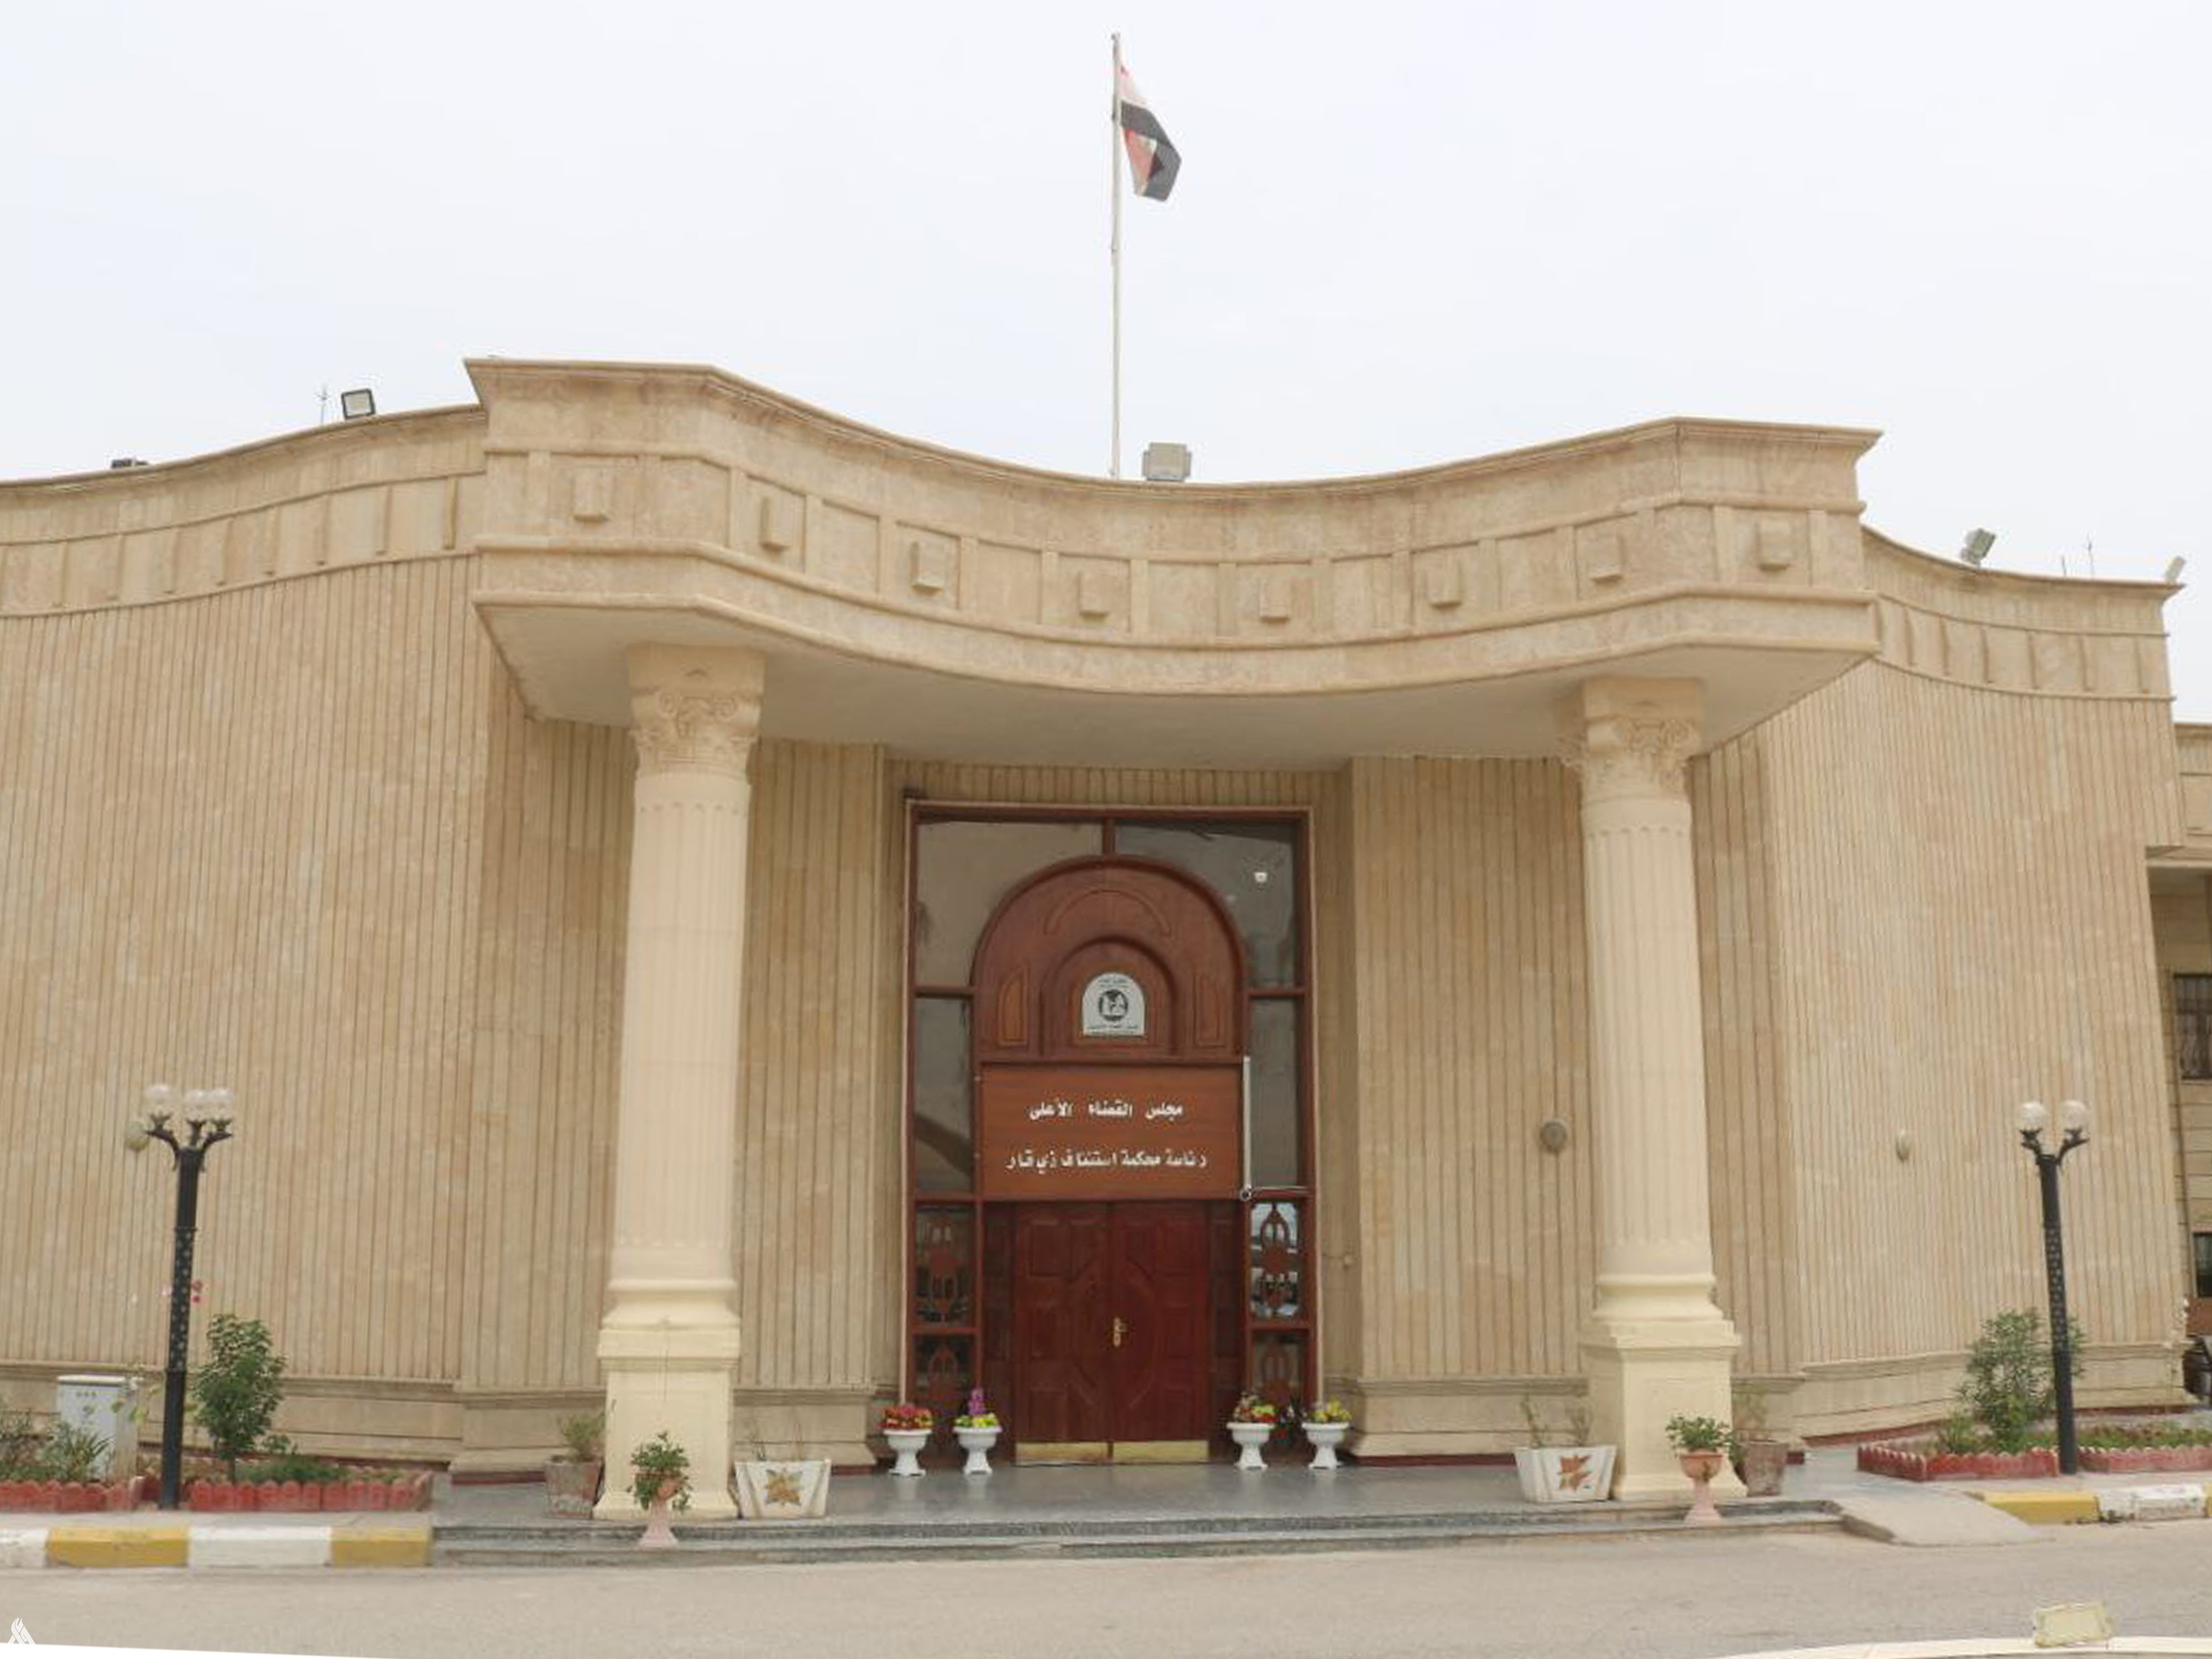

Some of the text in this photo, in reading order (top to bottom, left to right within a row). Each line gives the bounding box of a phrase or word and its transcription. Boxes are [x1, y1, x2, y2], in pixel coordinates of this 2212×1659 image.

[1088, 1099, 1133, 1117] القضاء
[1145, 1102, 1183, 1121] مجلس
[1005, 1149, 1034, 1169] قار
[1120, 1149, 1161, 1166] محكمة
